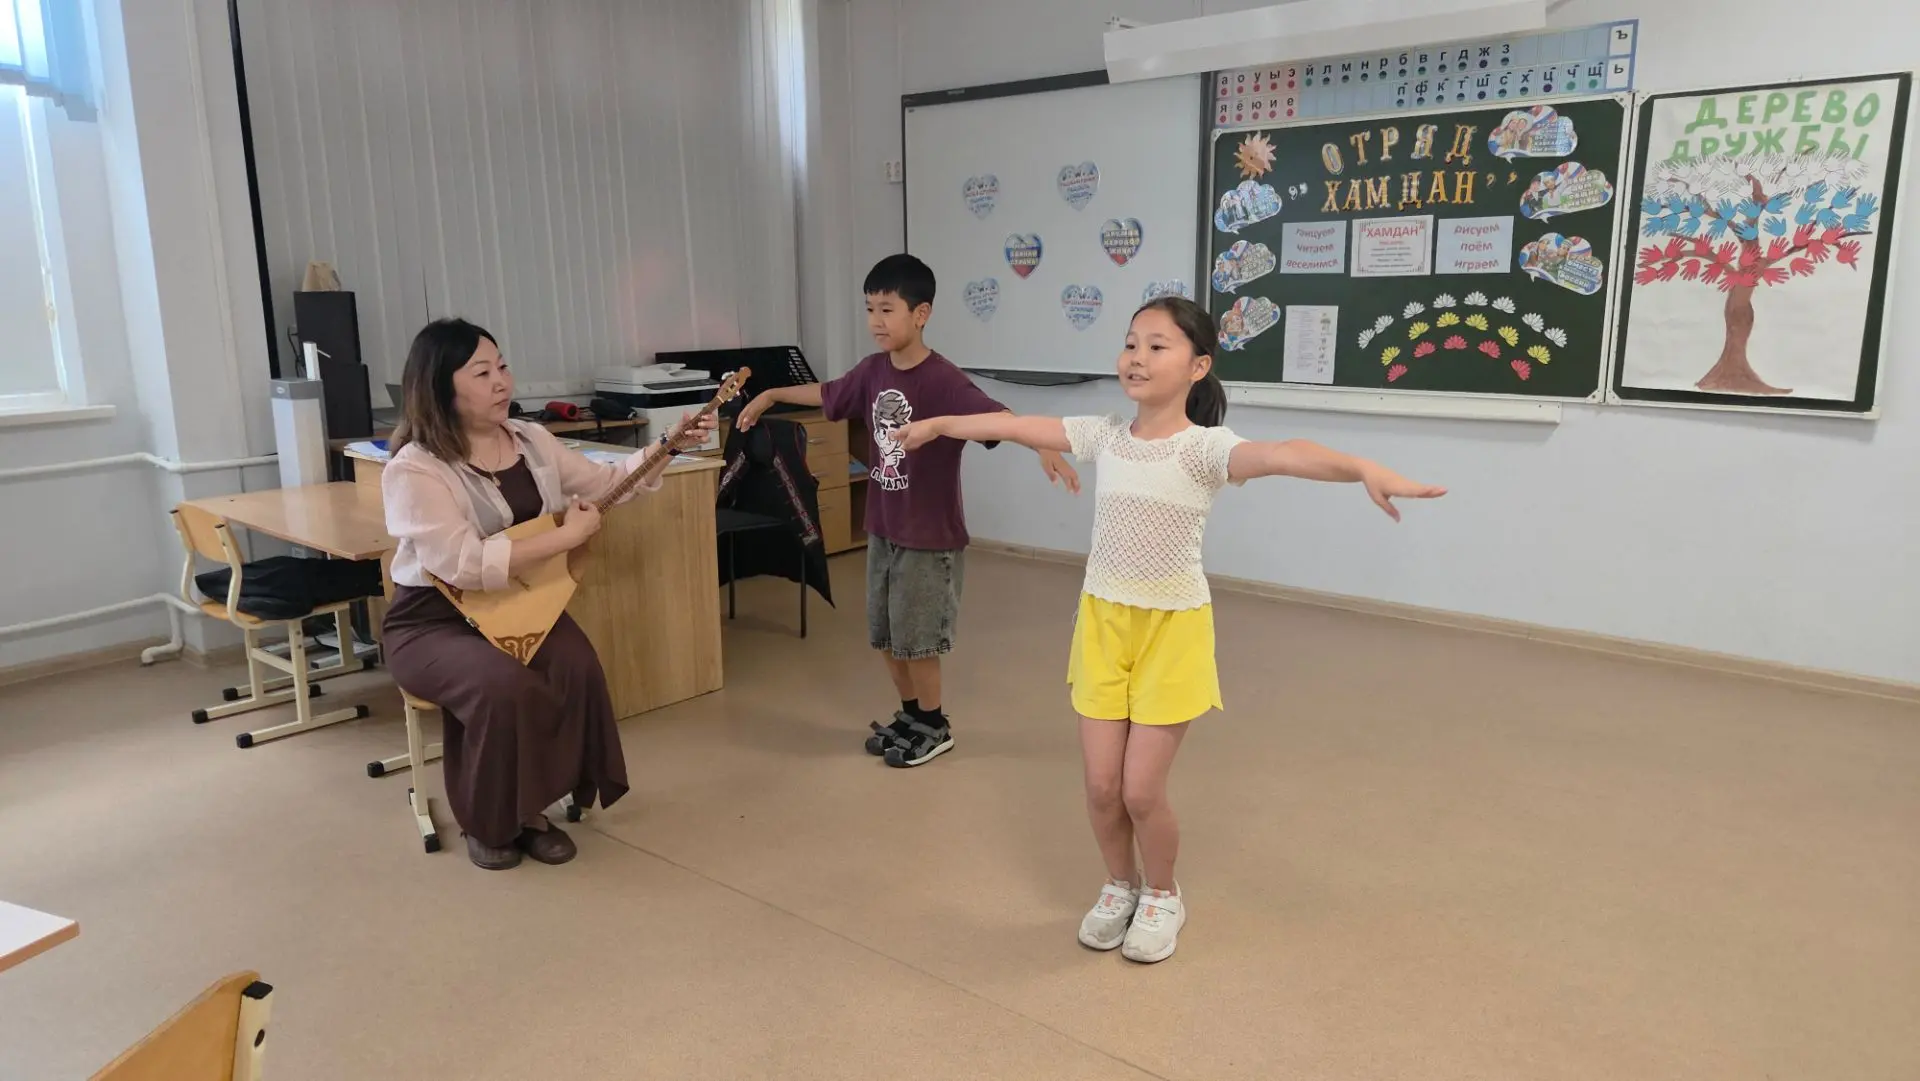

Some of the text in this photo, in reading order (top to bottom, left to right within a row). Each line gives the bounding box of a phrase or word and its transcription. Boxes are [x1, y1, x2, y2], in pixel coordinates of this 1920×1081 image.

[1685, 89, 1880, 135] ДЕРЕВО
[1321, 124, 1478, 175] ОТРЯД
[1664, 124, 1869, 165] ДРУЖБЫ
[1453, 223, 1500, 238] рисуем
[1296, 243, 1335, 254] читаем
[1286, 258, 1339, 270] веселимся
[1454, 258, 1500, 273] играем
